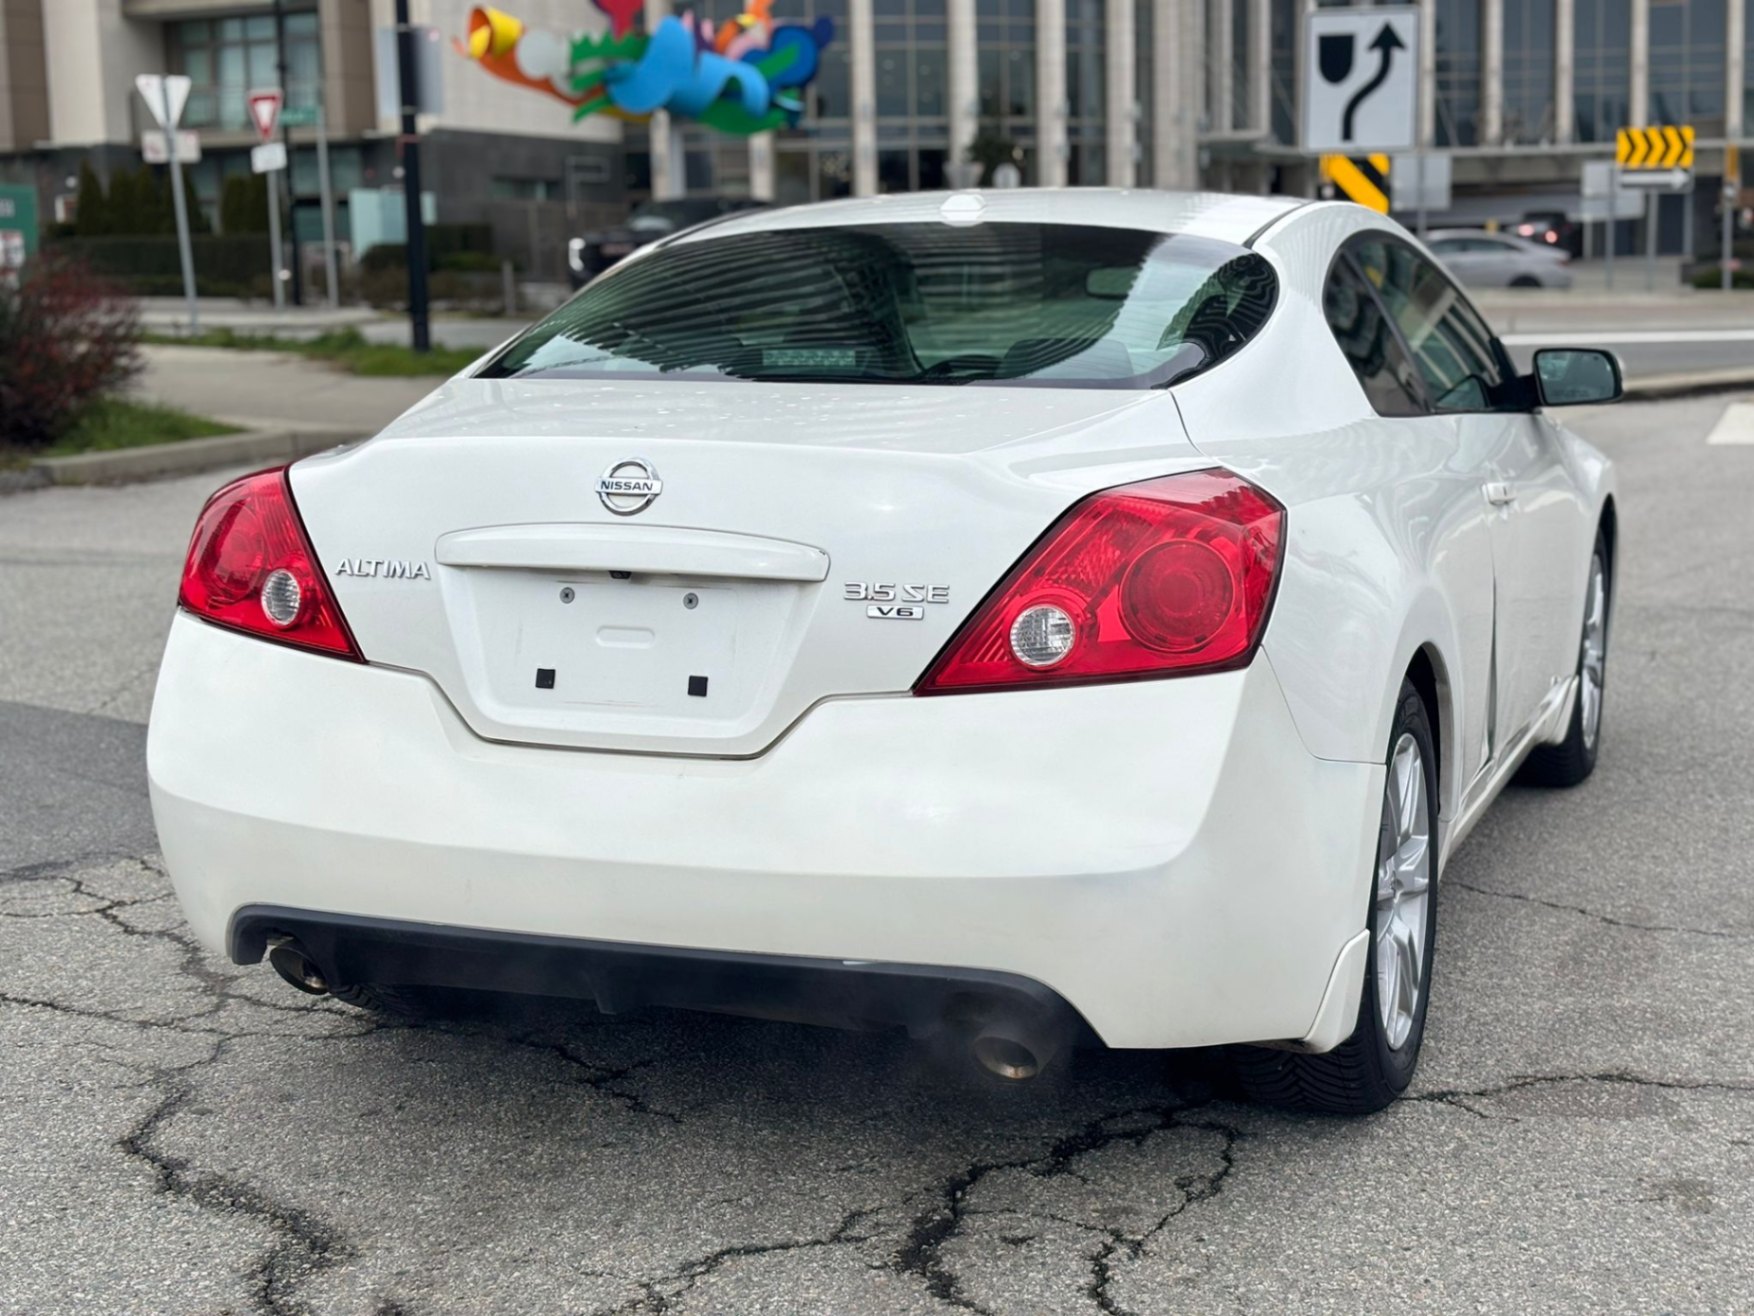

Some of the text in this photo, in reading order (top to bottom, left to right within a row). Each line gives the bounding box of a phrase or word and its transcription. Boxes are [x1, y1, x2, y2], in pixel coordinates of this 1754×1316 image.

[600, 480, 654, 492] NISSAN
[335, 558, 431, 580] ALTIMA
[843, 581, 950, 604] 3.5 SE
[876, 606, 914, 617] V6
